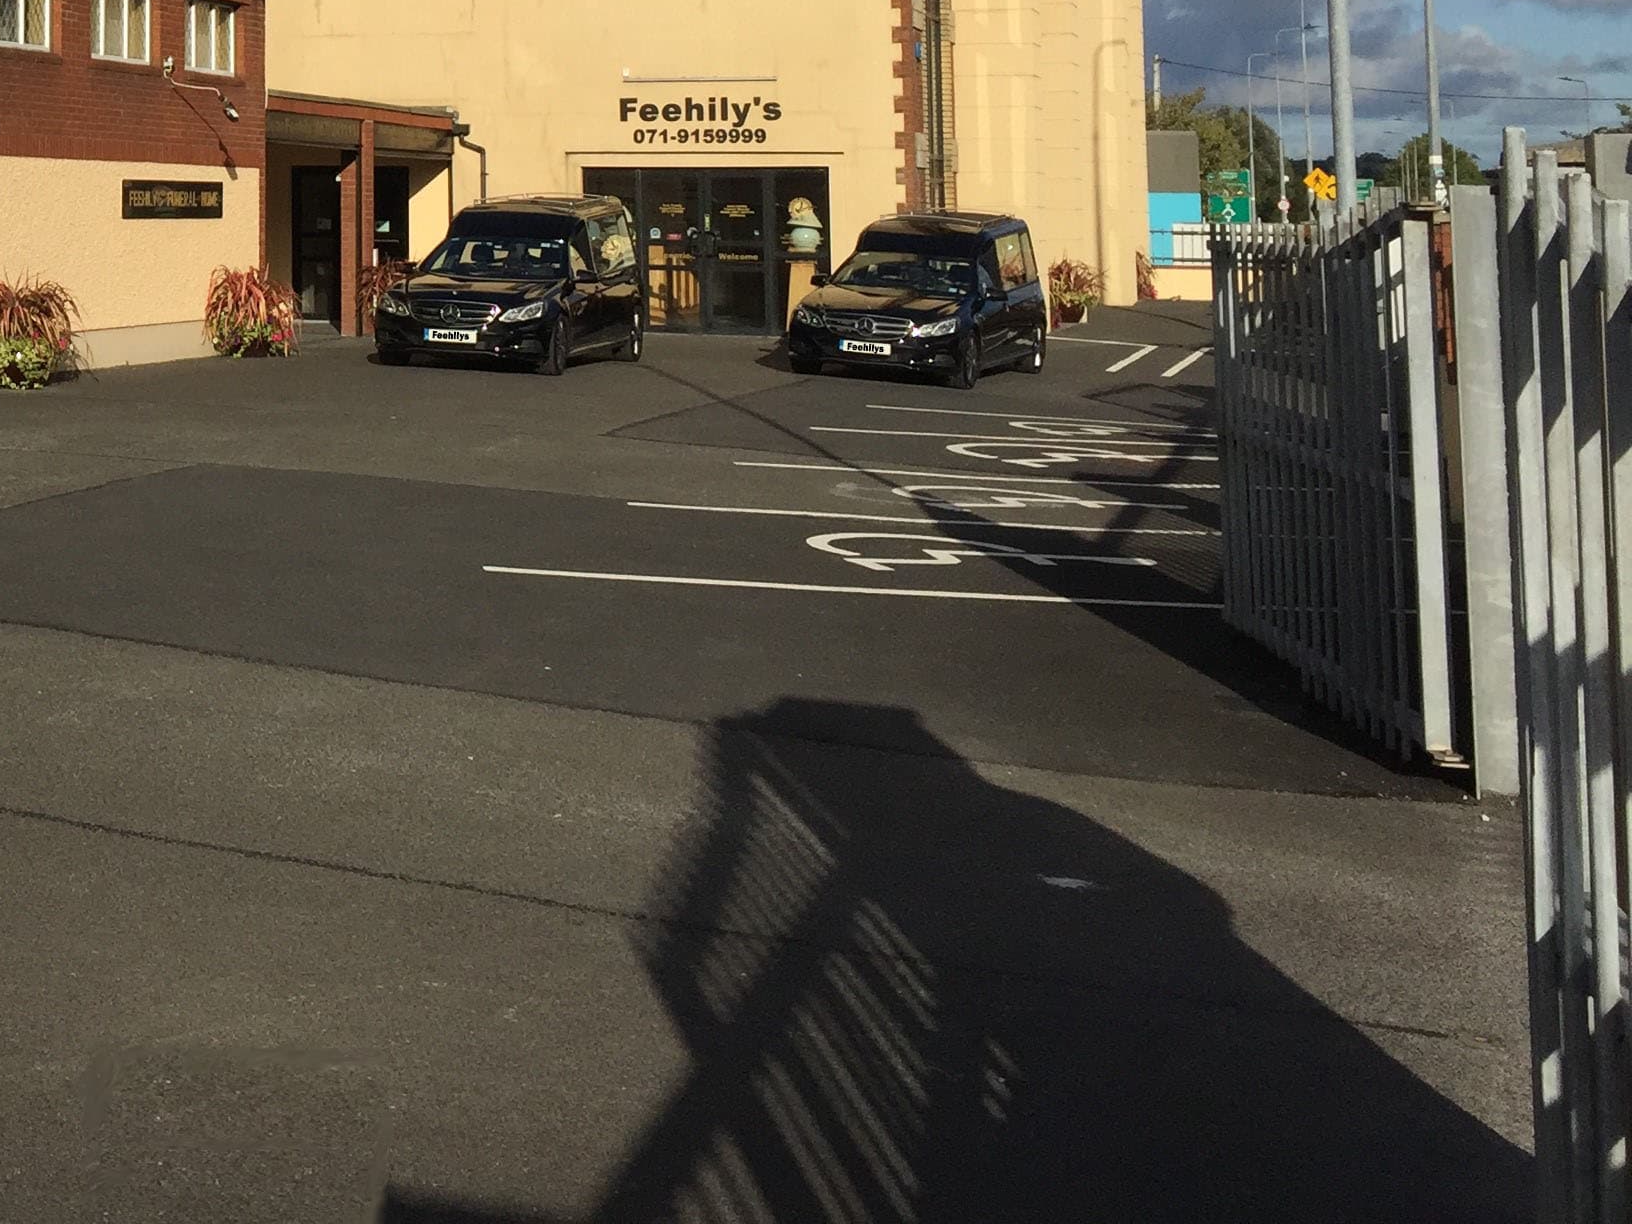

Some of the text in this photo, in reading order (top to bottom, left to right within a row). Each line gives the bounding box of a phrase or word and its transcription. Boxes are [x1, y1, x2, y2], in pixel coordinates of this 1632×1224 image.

[619, 96, 782, 128] Feehily's
[633, 128, 767, 144] 071-9159999
[718, 252, 759, 261] Welcome
